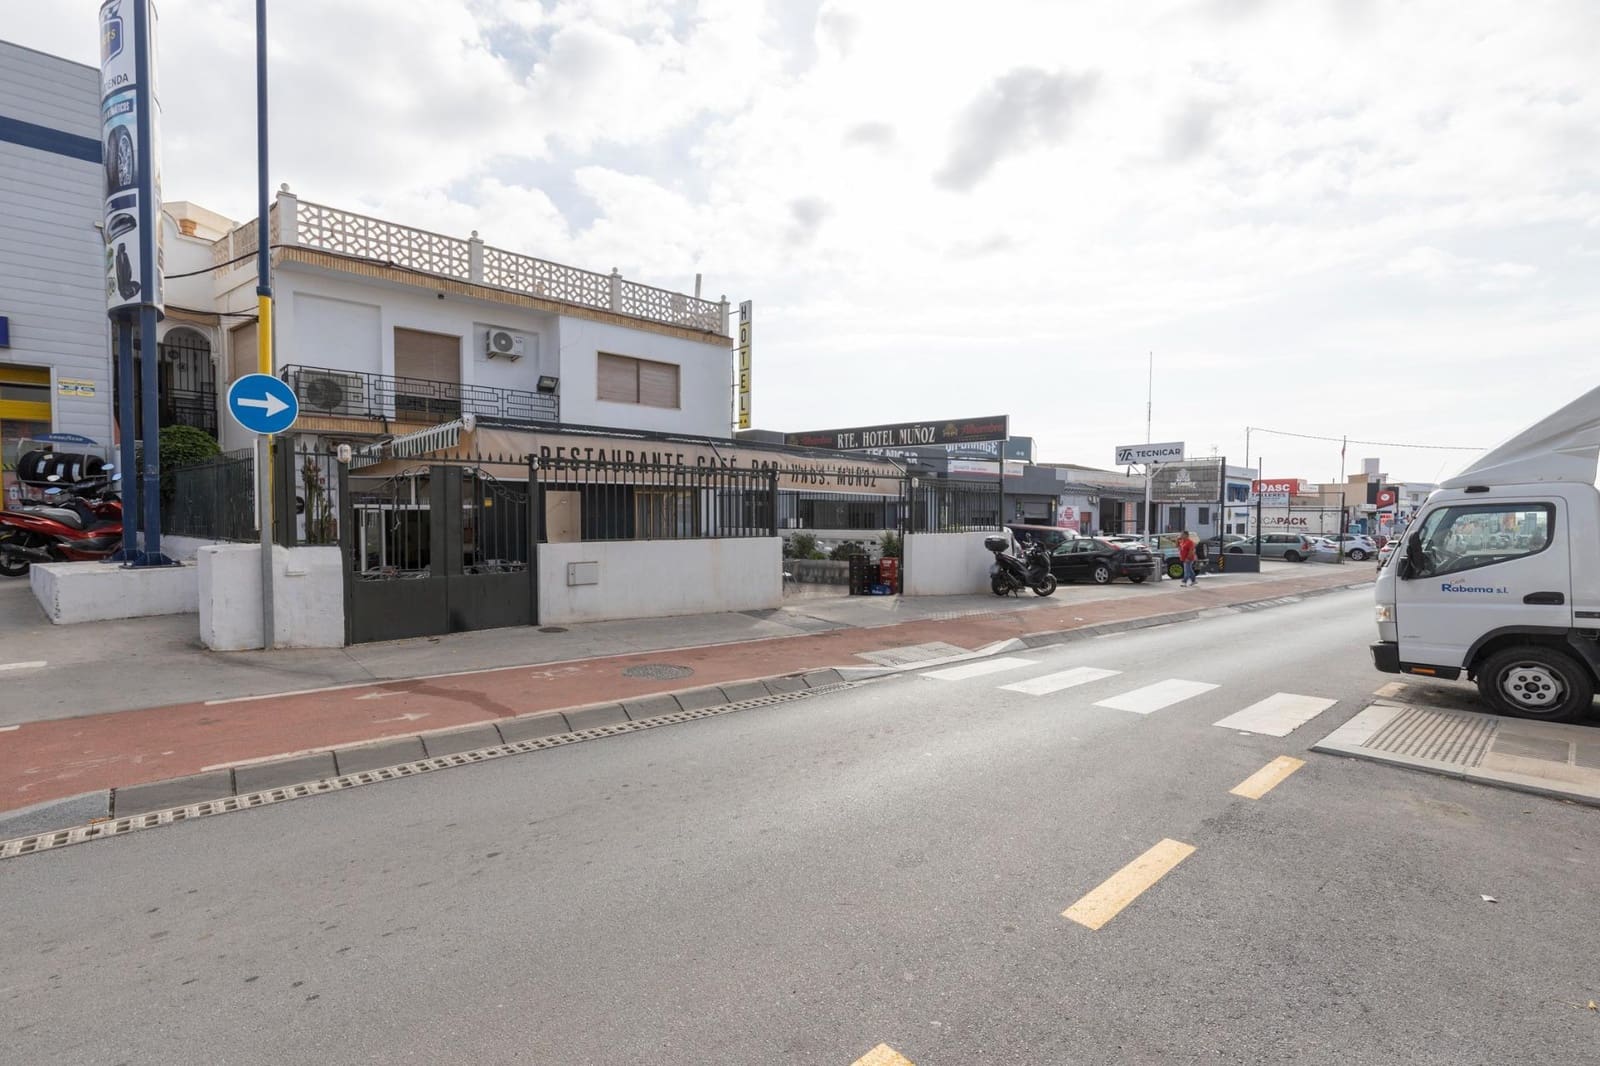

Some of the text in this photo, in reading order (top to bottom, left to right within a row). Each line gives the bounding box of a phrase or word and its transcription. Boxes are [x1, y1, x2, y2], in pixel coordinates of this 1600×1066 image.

[837, 432, 858, 449] RTE.
[862, 430, 895, 447] HOTEL
[899, 424, 936, 444] MUÑOZ
[540, 446, 685, 475] RESTAURANTE
[1135, 448, 1181, 457] TECNICAR
